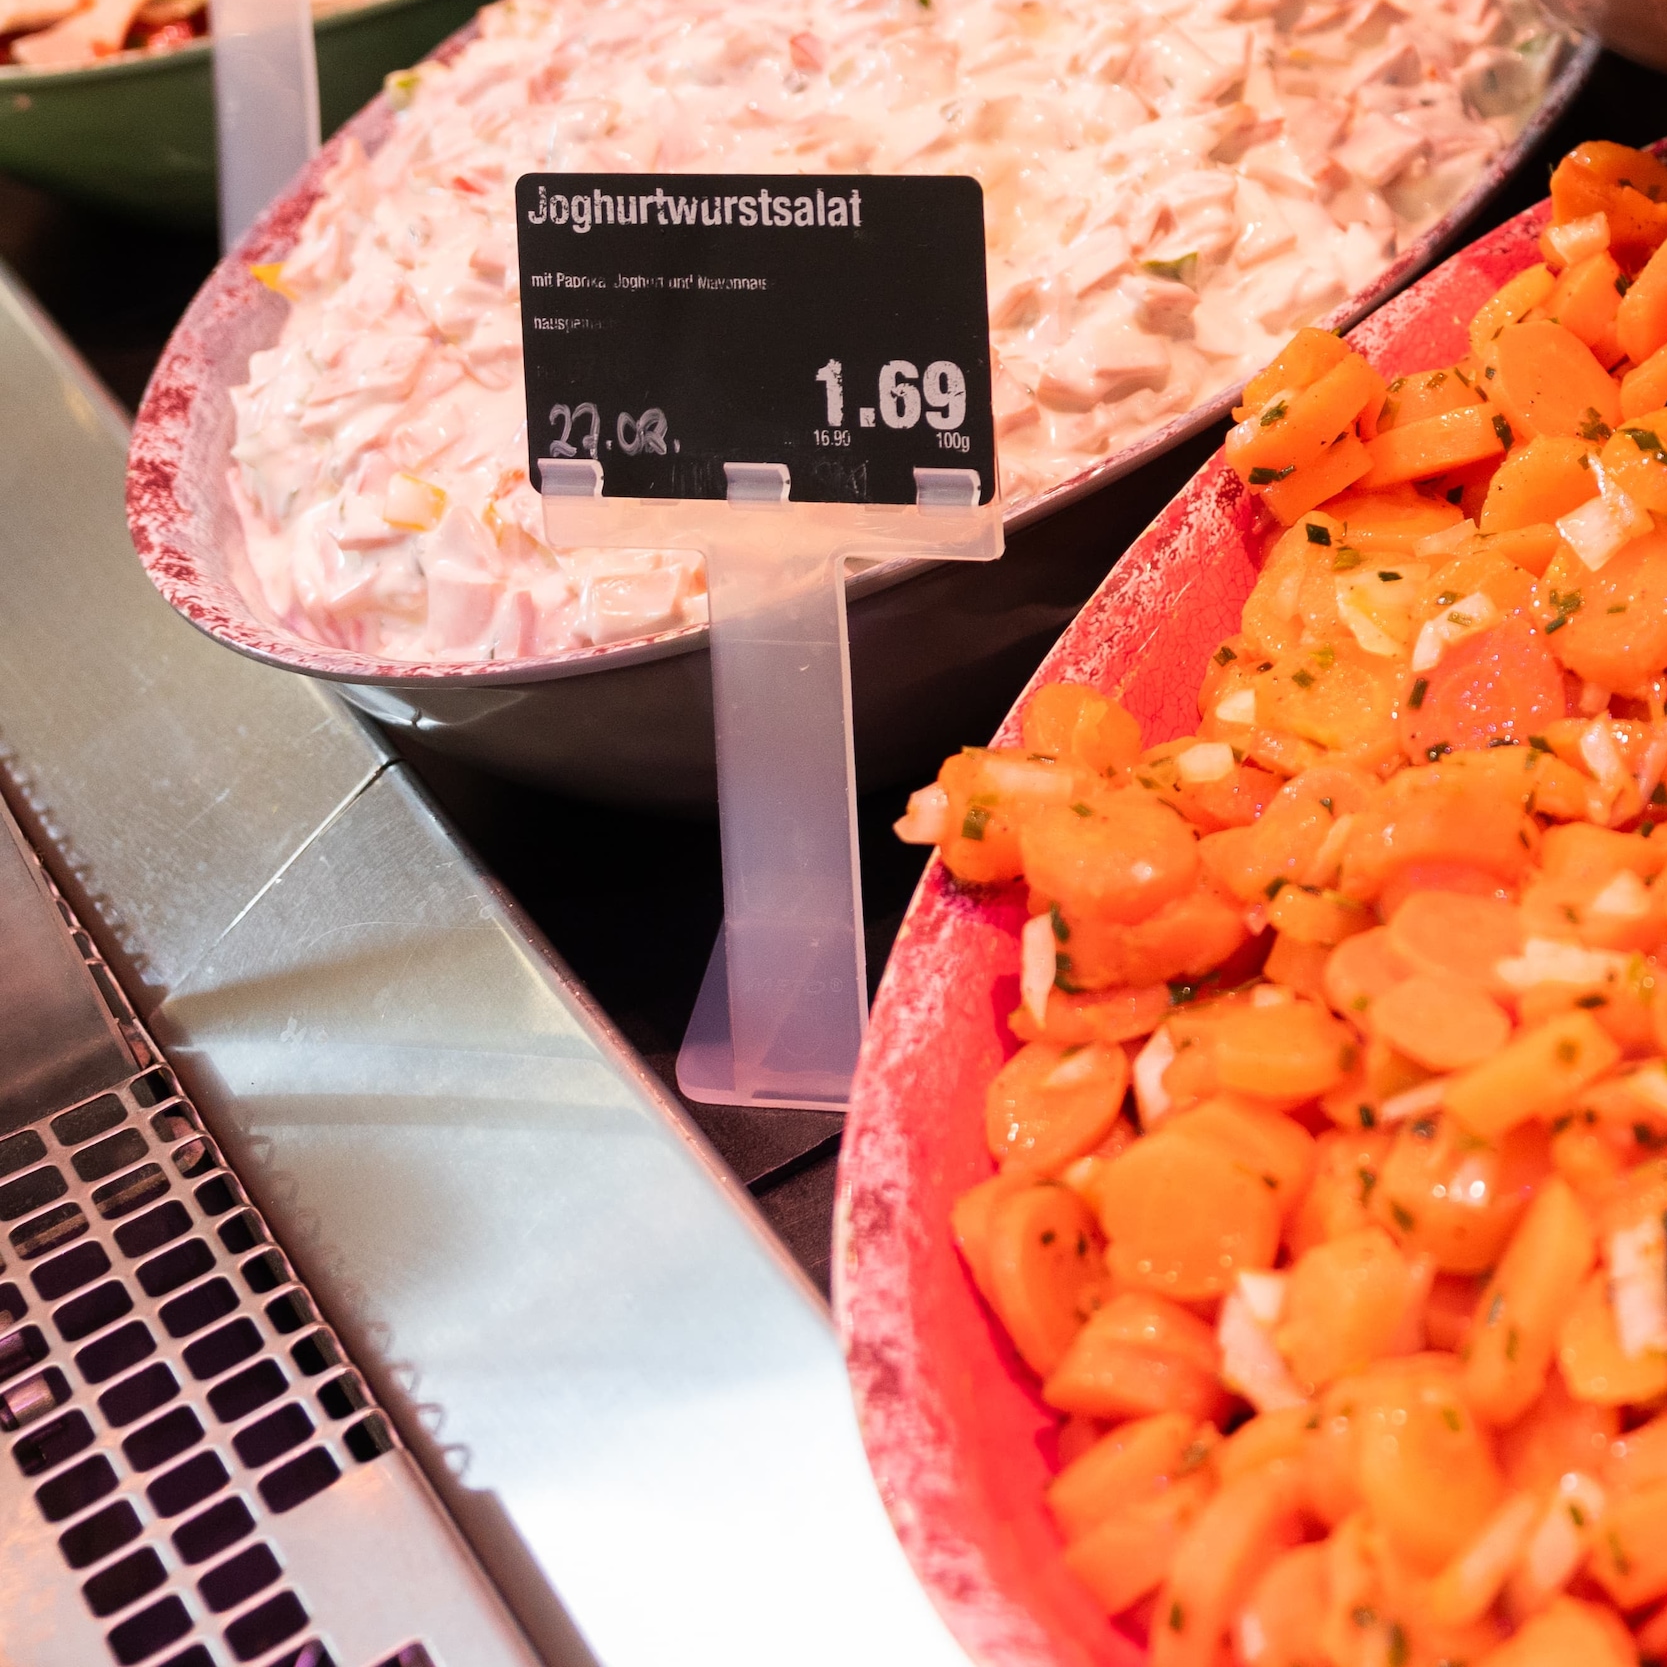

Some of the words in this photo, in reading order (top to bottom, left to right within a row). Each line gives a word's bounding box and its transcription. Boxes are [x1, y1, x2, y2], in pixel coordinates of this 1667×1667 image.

[528, 185, 862, 233] Joghurtwurstsalat
[531, 273, 553, 288] mit
[815, 359, 967, 431] 1.69
[814, 430, 851, 447] 16.90
[936, 432, 971, 452] 100g
